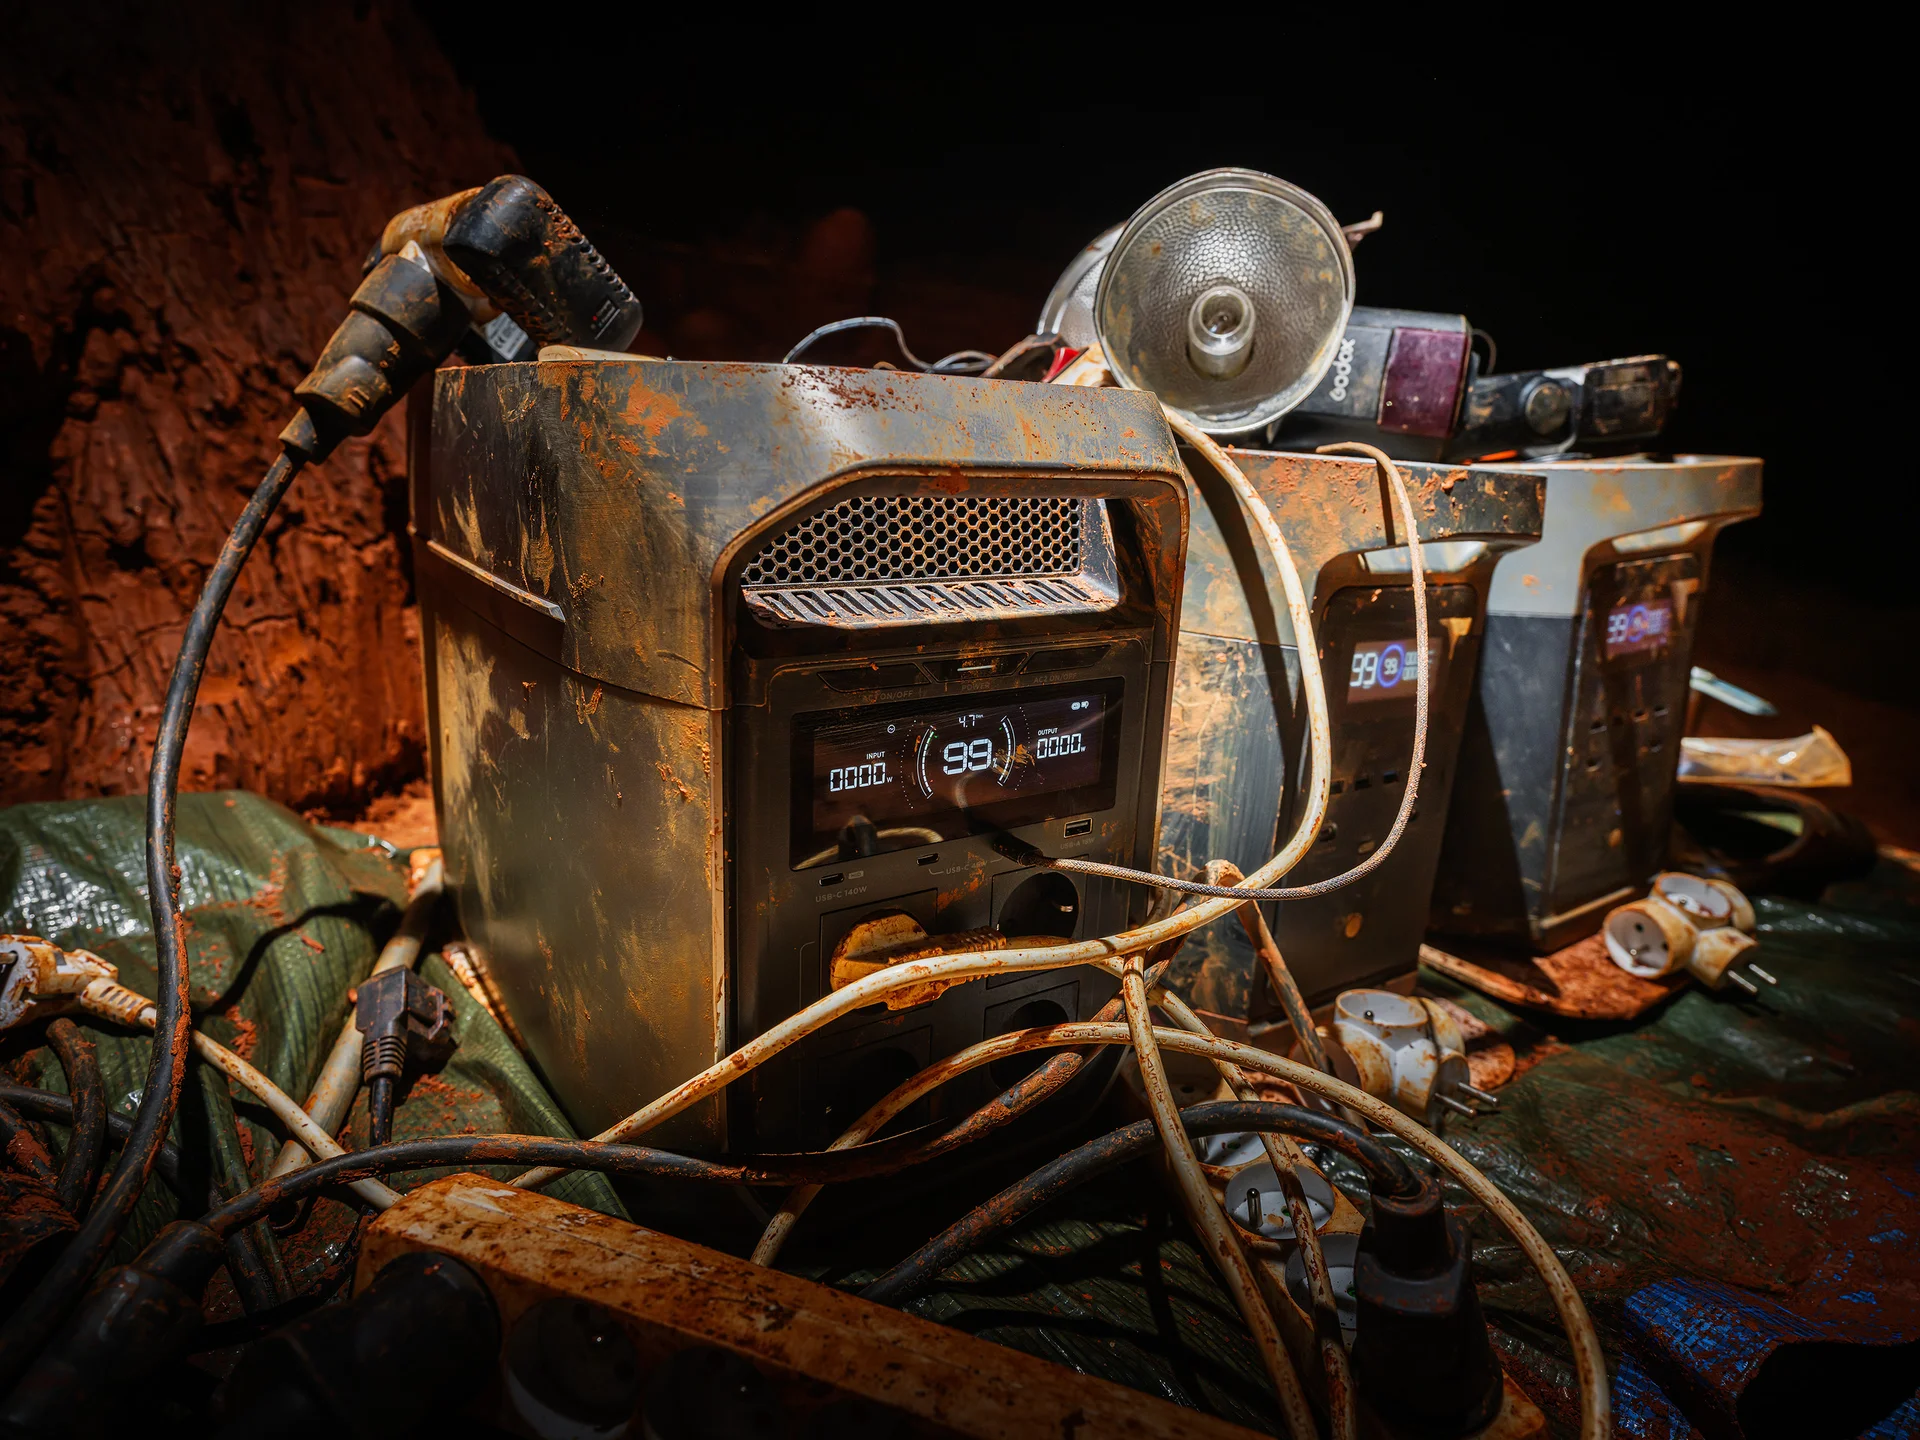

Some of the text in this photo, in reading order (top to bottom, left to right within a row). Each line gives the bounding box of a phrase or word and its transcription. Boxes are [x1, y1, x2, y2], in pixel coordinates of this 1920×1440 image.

[1329, 338, 1356, 402] Godox
[1033, 672, 1078, 684] AC2 ON/OFF
[1349, 652, 1379, 688] 99
[880, 690, 914, 700] ON/OFF
[961, 682, 991, 692] POWER
[958, 714, 975, 728] 4.7
[1037, 728, 1059, 736] OUTPUT
[866, 750, 886, 760] INPUT
[1036, 733, 1082, 760] 0000
[943, 738, 993, 775] 99
[829, 761, 886, 793] 0000
[1060, 841, 1081, 850] USB-A
[945, 863, 970, 875] USB-C
[815, 885, 868, 903] USB-C 140W
[1178, 1041, 1227, 1059] ELECTRIC
[1237, 1055, 1281, 1074] JIAMING
[1291, 1073, 1328, 1094] YUYAO
